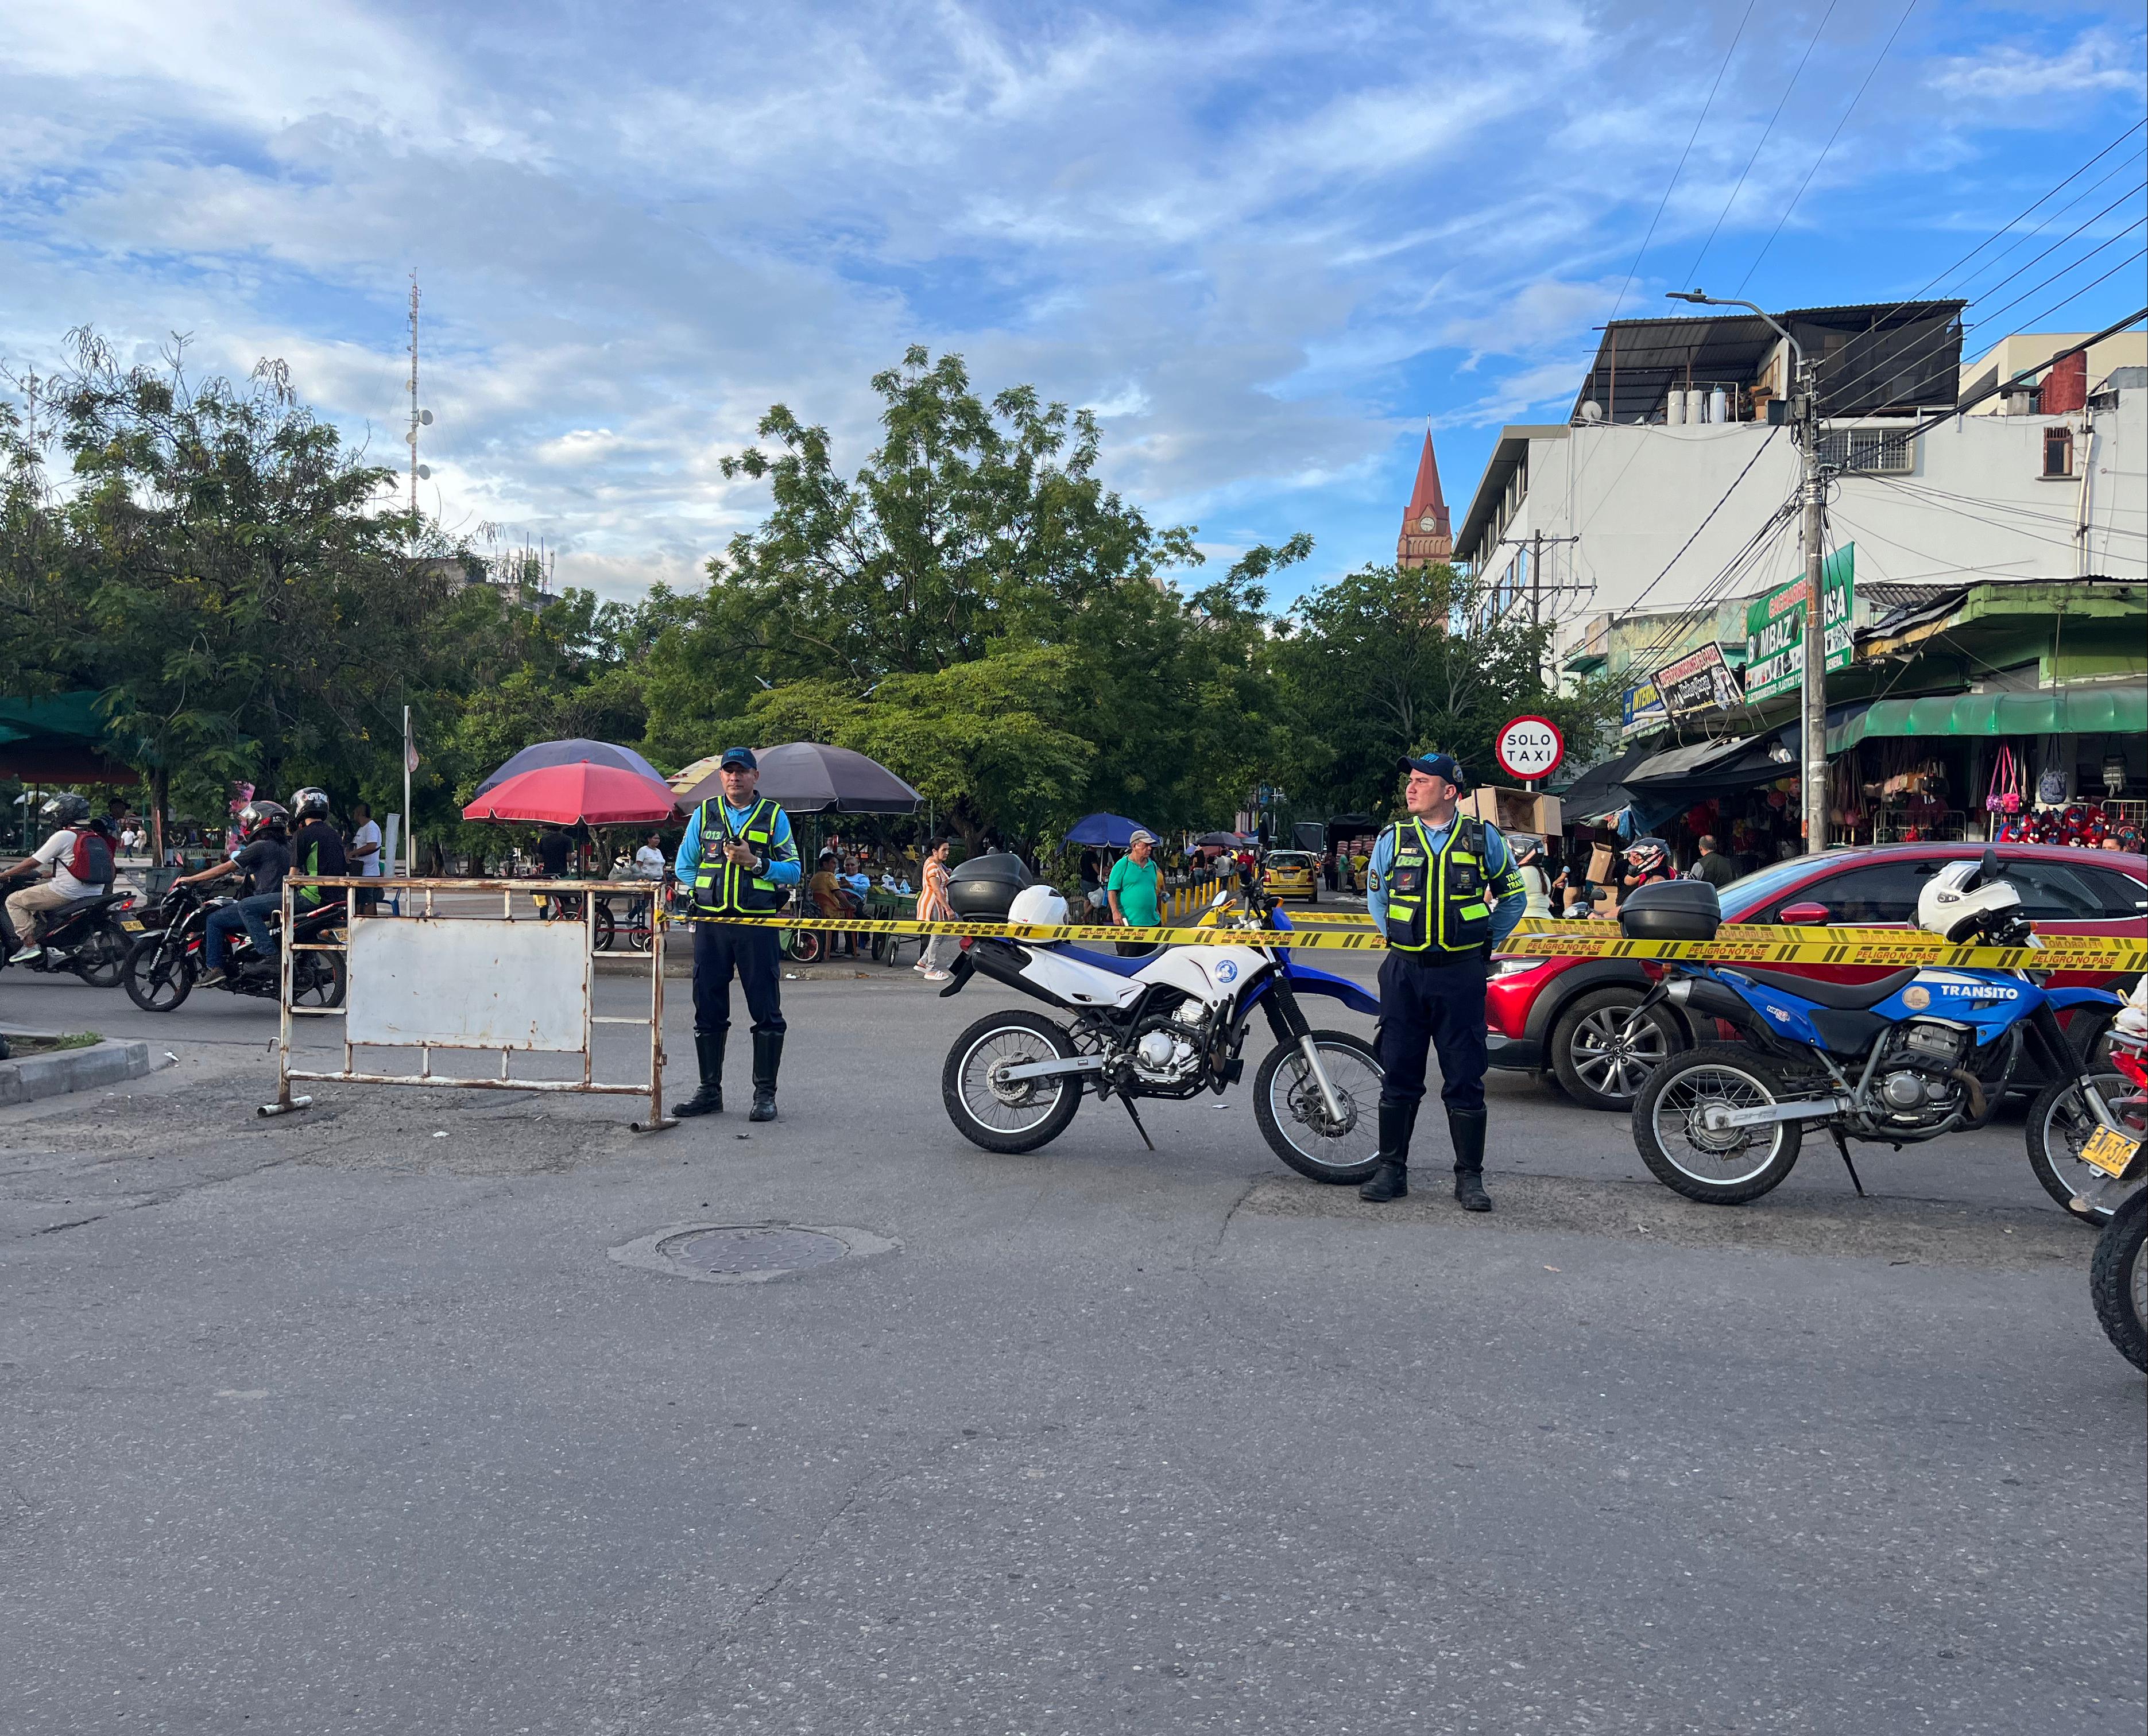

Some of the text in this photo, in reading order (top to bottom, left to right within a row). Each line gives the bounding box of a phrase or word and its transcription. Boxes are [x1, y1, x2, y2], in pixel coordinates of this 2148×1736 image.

[1769, 578, 1806, 618] CACHARRE
[1824, 586, 1846, 627] ISA
[1507, 734, 1550, 745] SOLO
[1507, 750, 1550, 761] TAXI
[706, 831, 721, 840] 013
[1856, 951, 1895, 959] PELIGRO
[1915, 952, 1938, 960] PASE
[2032, 955, 2116, 964] PELIGRO NO PASE
[1941, 985, 2018, 999] TRANSITO
